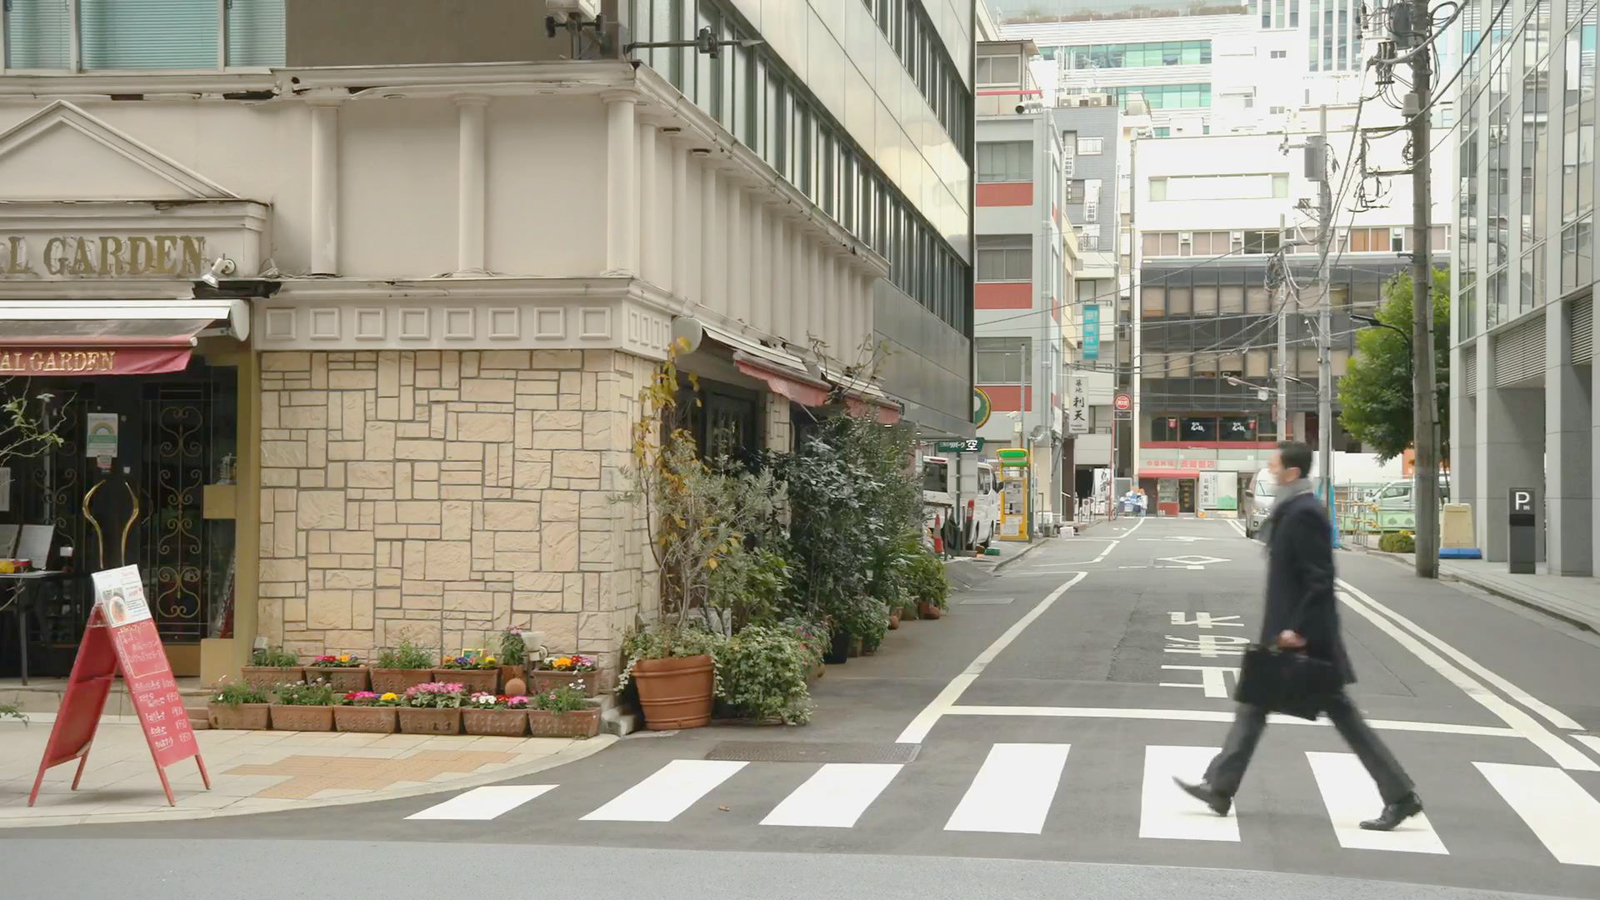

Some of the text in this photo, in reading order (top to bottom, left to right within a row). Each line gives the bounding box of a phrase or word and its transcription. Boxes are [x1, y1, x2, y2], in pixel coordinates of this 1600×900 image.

[43, 235, 206, 275] GARDEN
[29, 350, 116, 372] GARDEN
[966, 440, 978, 451] 空
[1515, 492, 1530, 510] P
